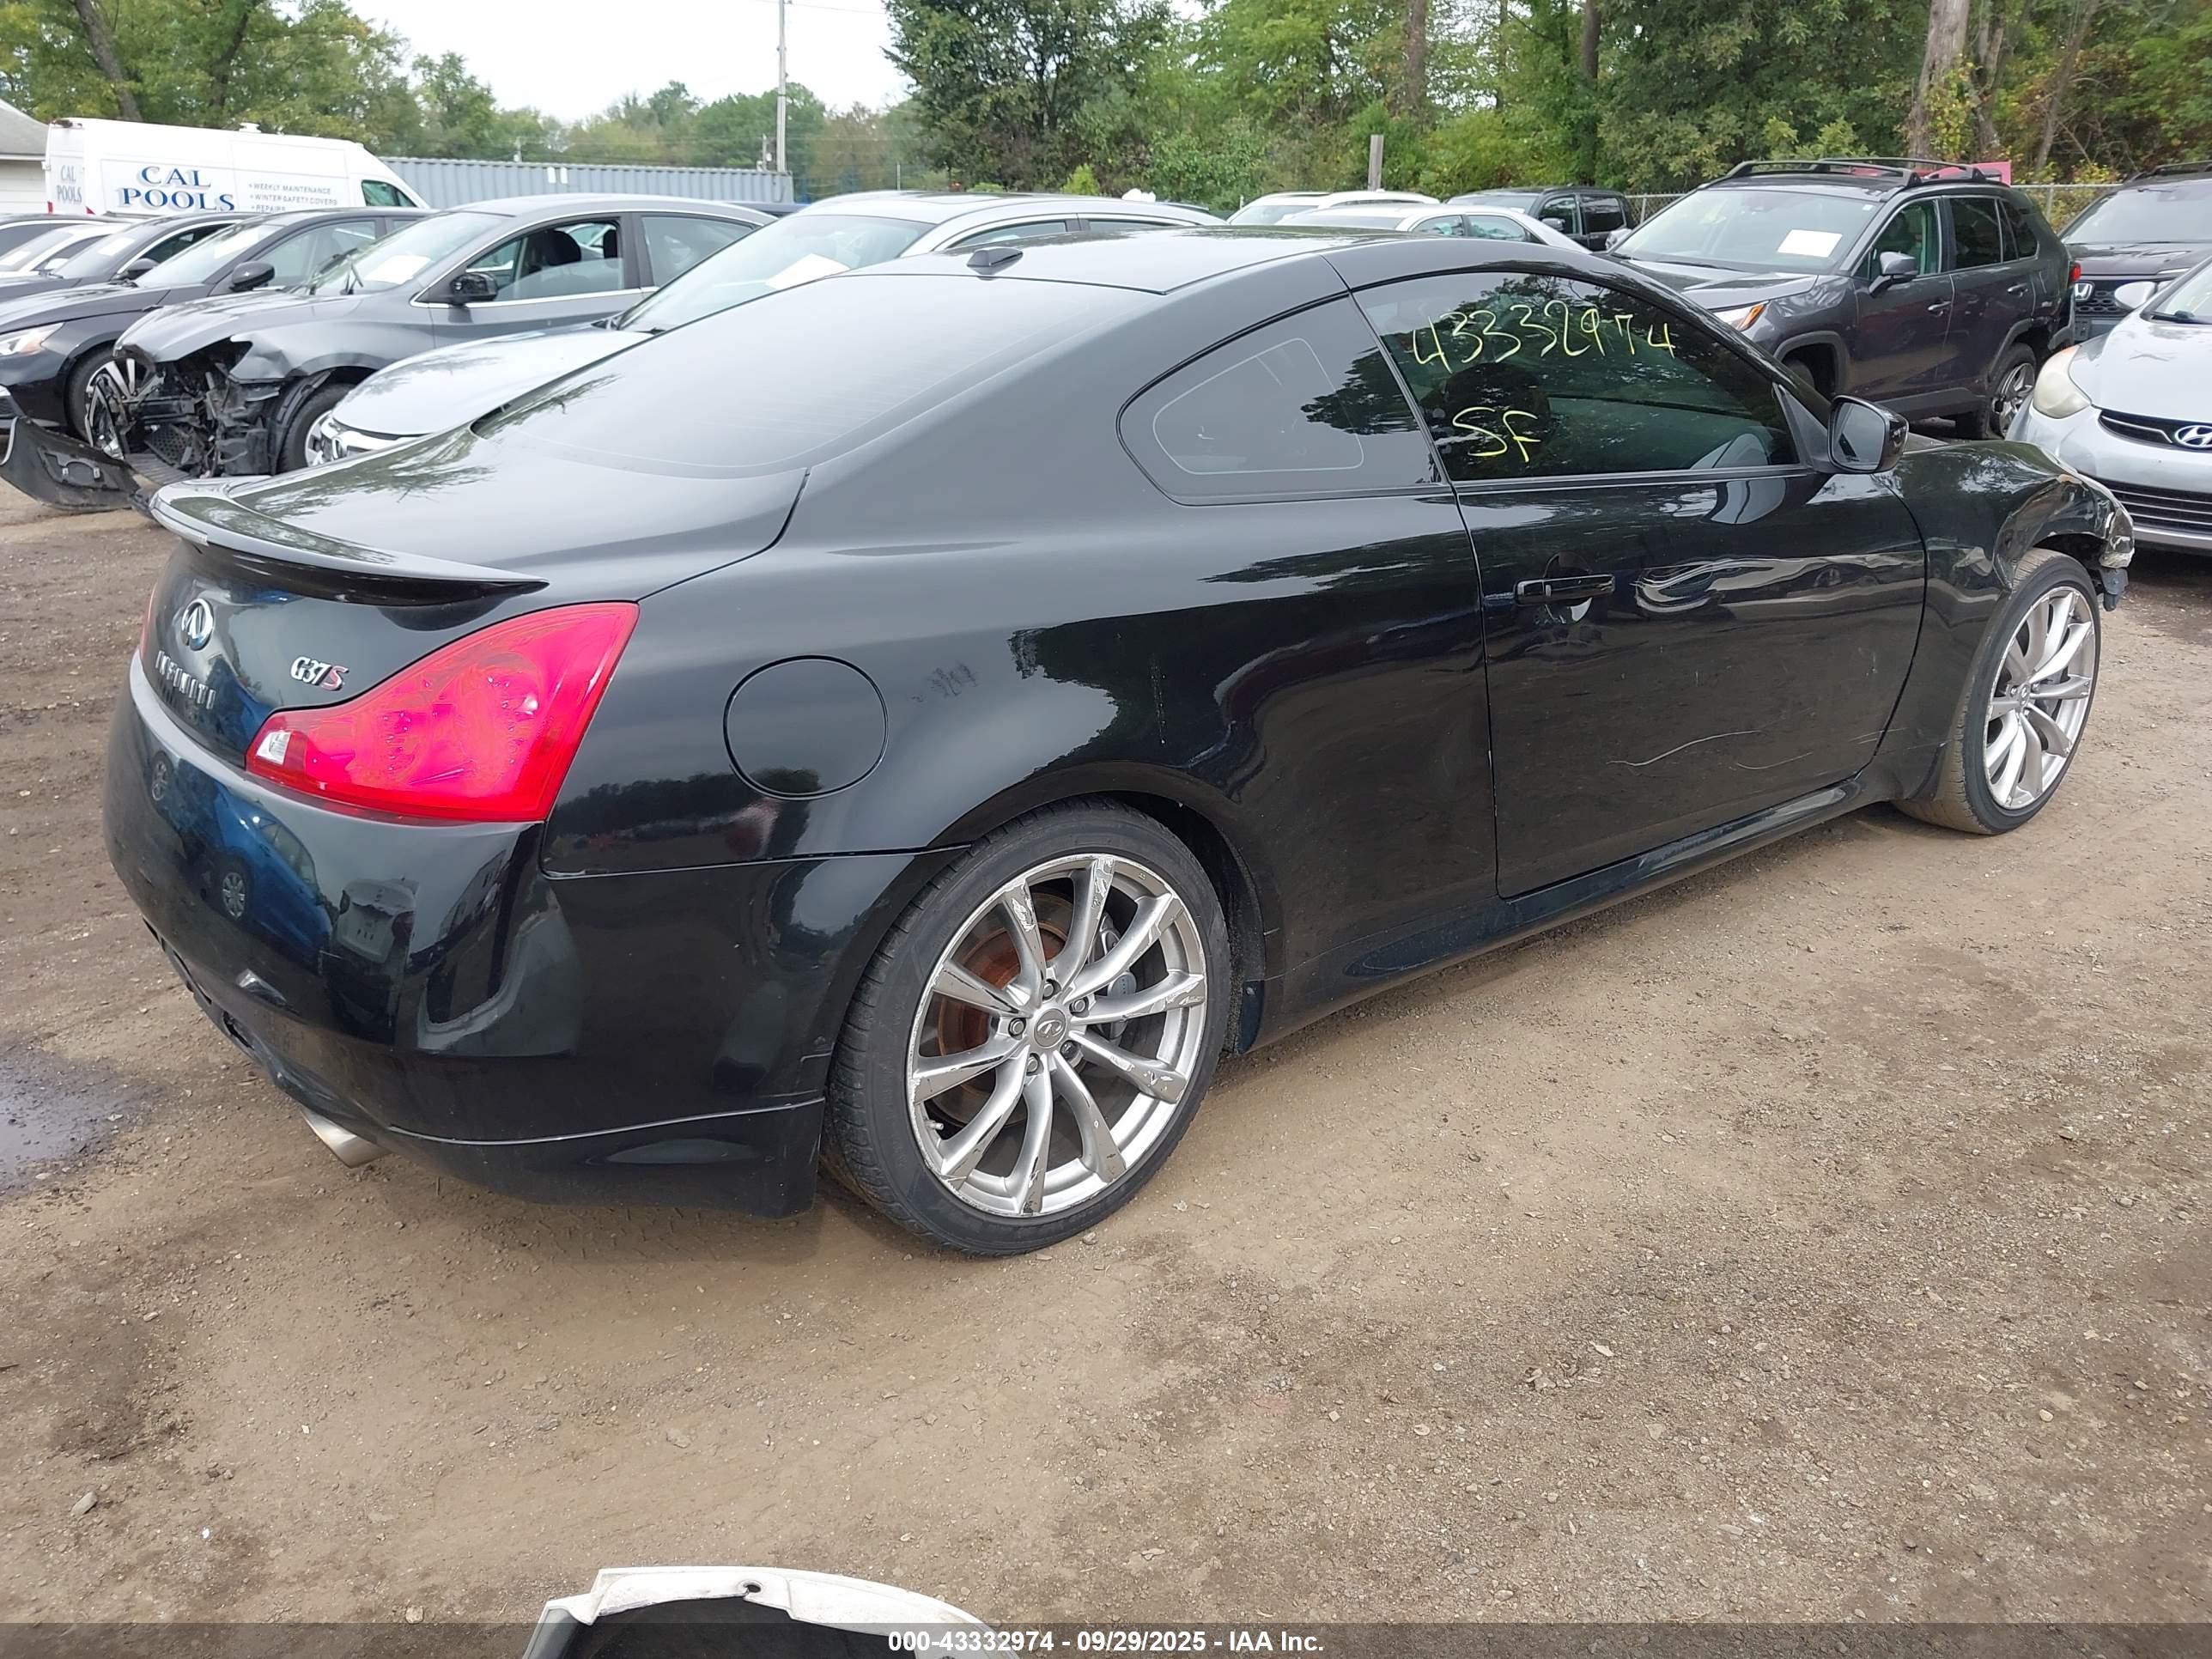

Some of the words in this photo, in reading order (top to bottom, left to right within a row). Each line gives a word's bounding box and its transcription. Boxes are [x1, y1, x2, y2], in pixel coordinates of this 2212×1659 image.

[61, 165, 76, 182] CAL
[139, 166, 211, 187] CAL
[57, 185, 82, 204] POOLS
[120, 187, 235, 211] POOLS
[283, 185, 331, 194] MAINTENANCE
[1413, 300, 1676, 374] 43332974
[1452, 406, 1540, 463] SF
[155, 650, 216, 709] INFINITI
[290, 656, 349, 691] G37S
